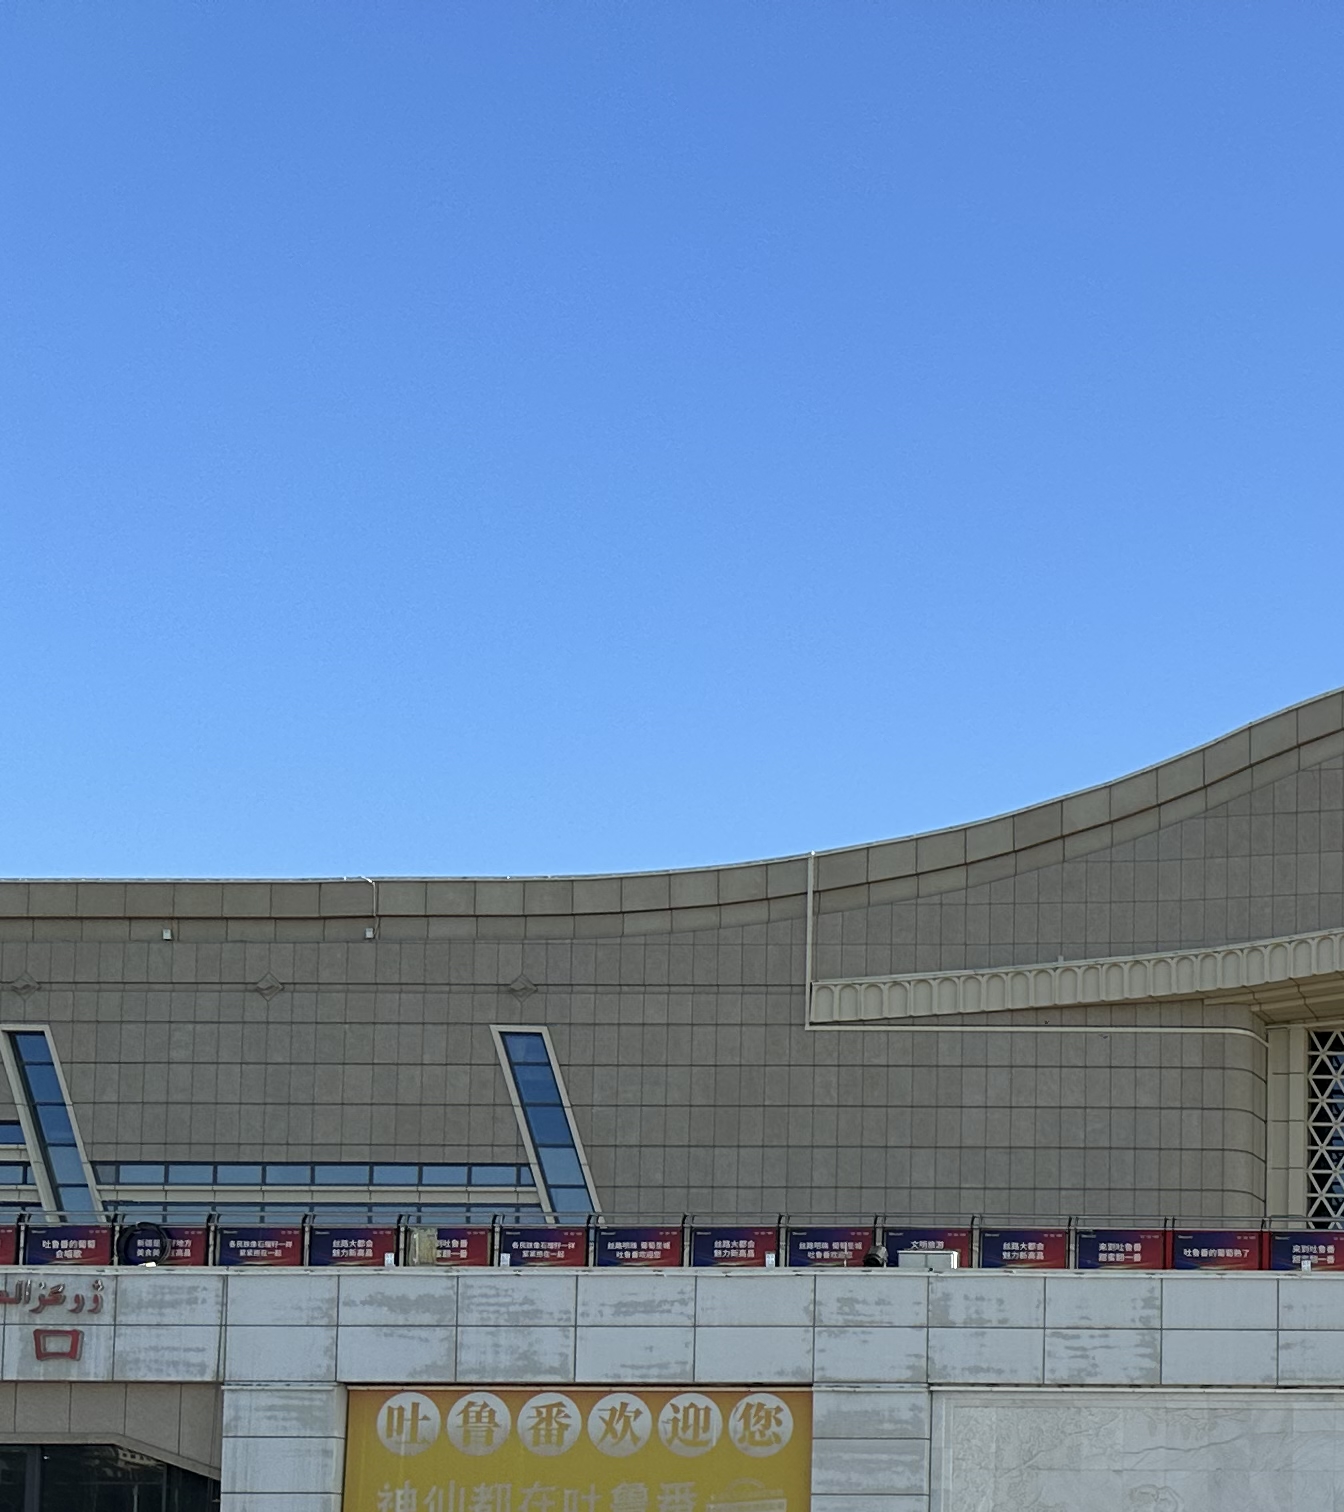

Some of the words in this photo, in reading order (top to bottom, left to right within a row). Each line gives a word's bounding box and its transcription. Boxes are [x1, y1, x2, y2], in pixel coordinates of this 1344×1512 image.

[42, 1239, 96, 1249] 吐鲁番的葡萄
[1183, 1248, 1250, 1258] 吐鲁番的葡萄熟了
[33, 1329, 84, 1361] 口
[384, 1400, 784, 1448] 吐鲁番欢迎您
